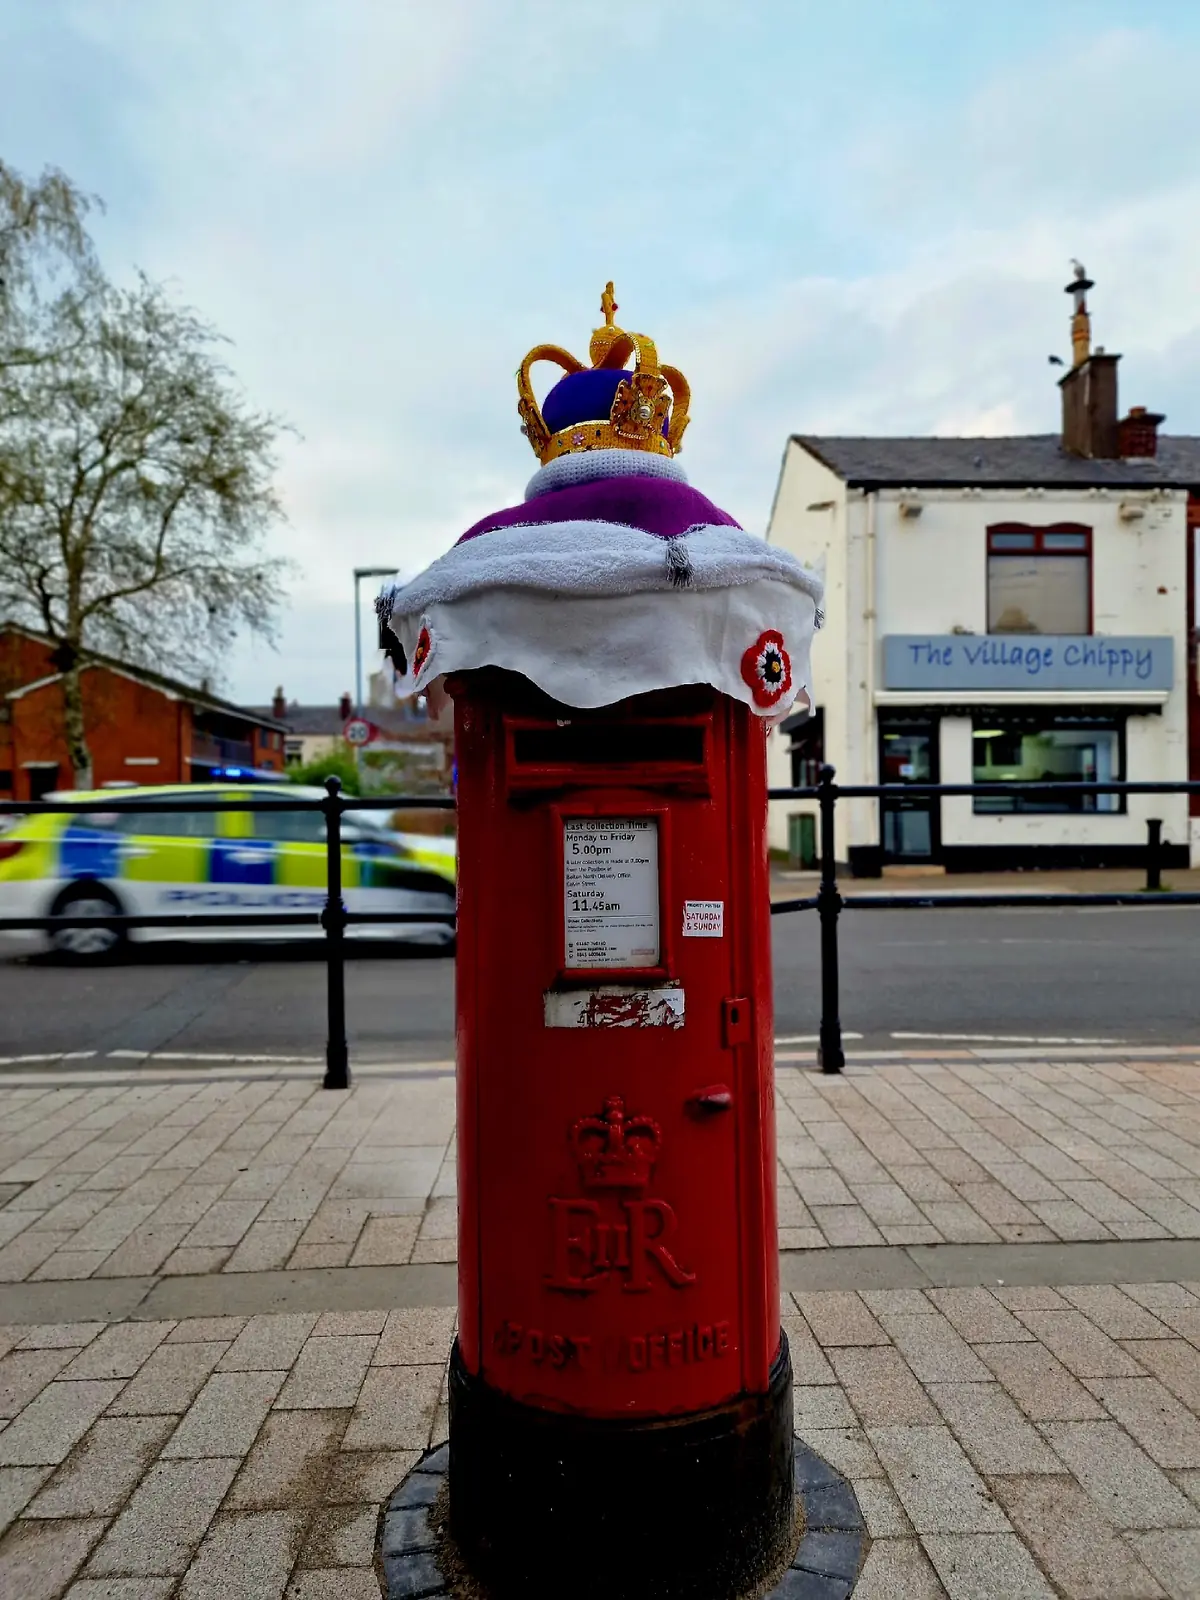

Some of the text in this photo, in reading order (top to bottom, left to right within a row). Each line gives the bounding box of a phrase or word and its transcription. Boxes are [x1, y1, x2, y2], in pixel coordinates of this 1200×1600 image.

[908, 640, 1153, 680] The Village Chippy
[350, 727, 366, 740] 20
[566, 820, 648, 831] Last Collection Time
[566, 834, 597, 843] Monday
[610, 833, 636, 842] Friday
[572, 843, 612, 856] 5.00pm
[567, 890, 605, 898] Saturday
[572, 899, 620, 911] 11.45am
[686, 912, 720, 920] SATURDAY
[502, 1319, 731, 1373] POST OFFICE
